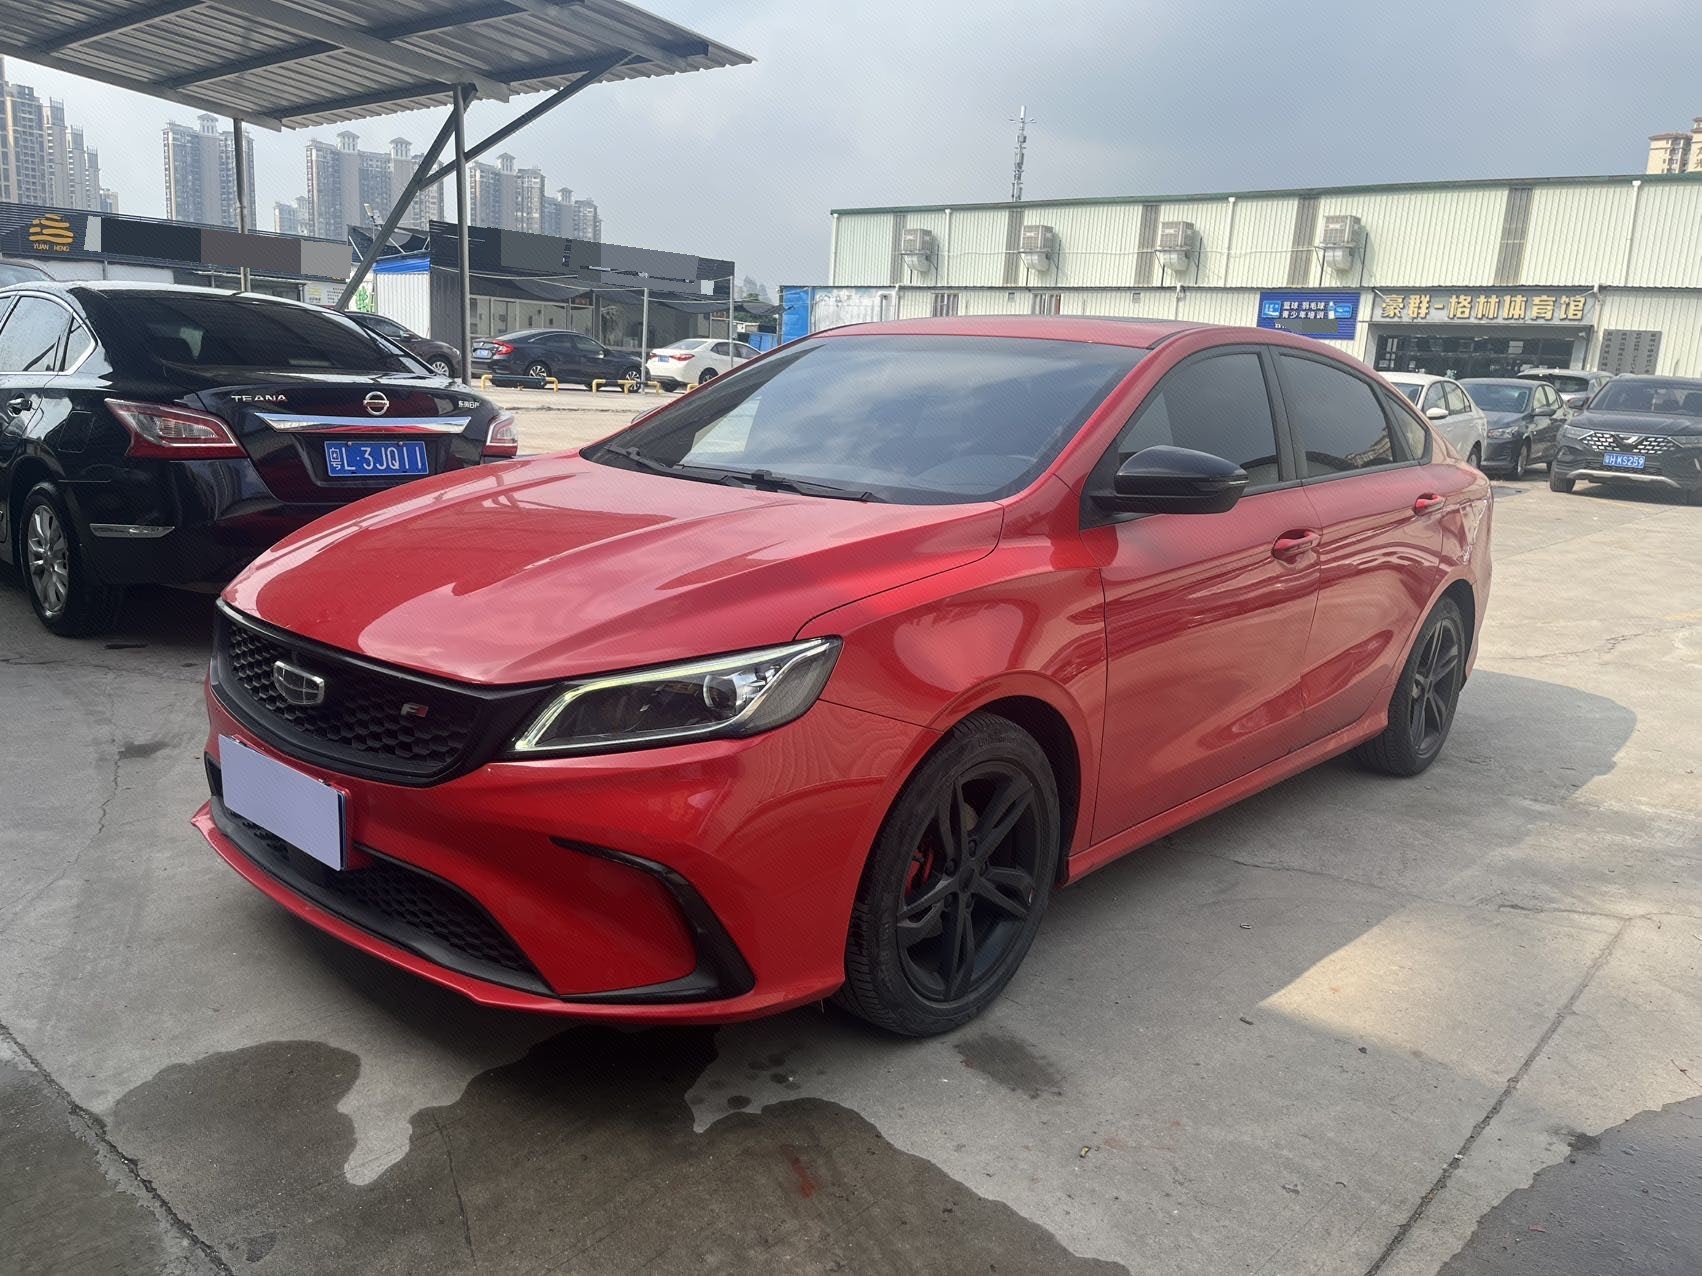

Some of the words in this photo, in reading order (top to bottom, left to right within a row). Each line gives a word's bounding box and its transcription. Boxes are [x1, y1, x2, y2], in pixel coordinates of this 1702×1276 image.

[1301, 301, 1326, 310] 羽毛球
[1382, 294, 1586, 320] 豪群-格林体育馆
[1282, 310, 1325, 319] 青少年培训
[231, 394, 289, 403] TEANA
